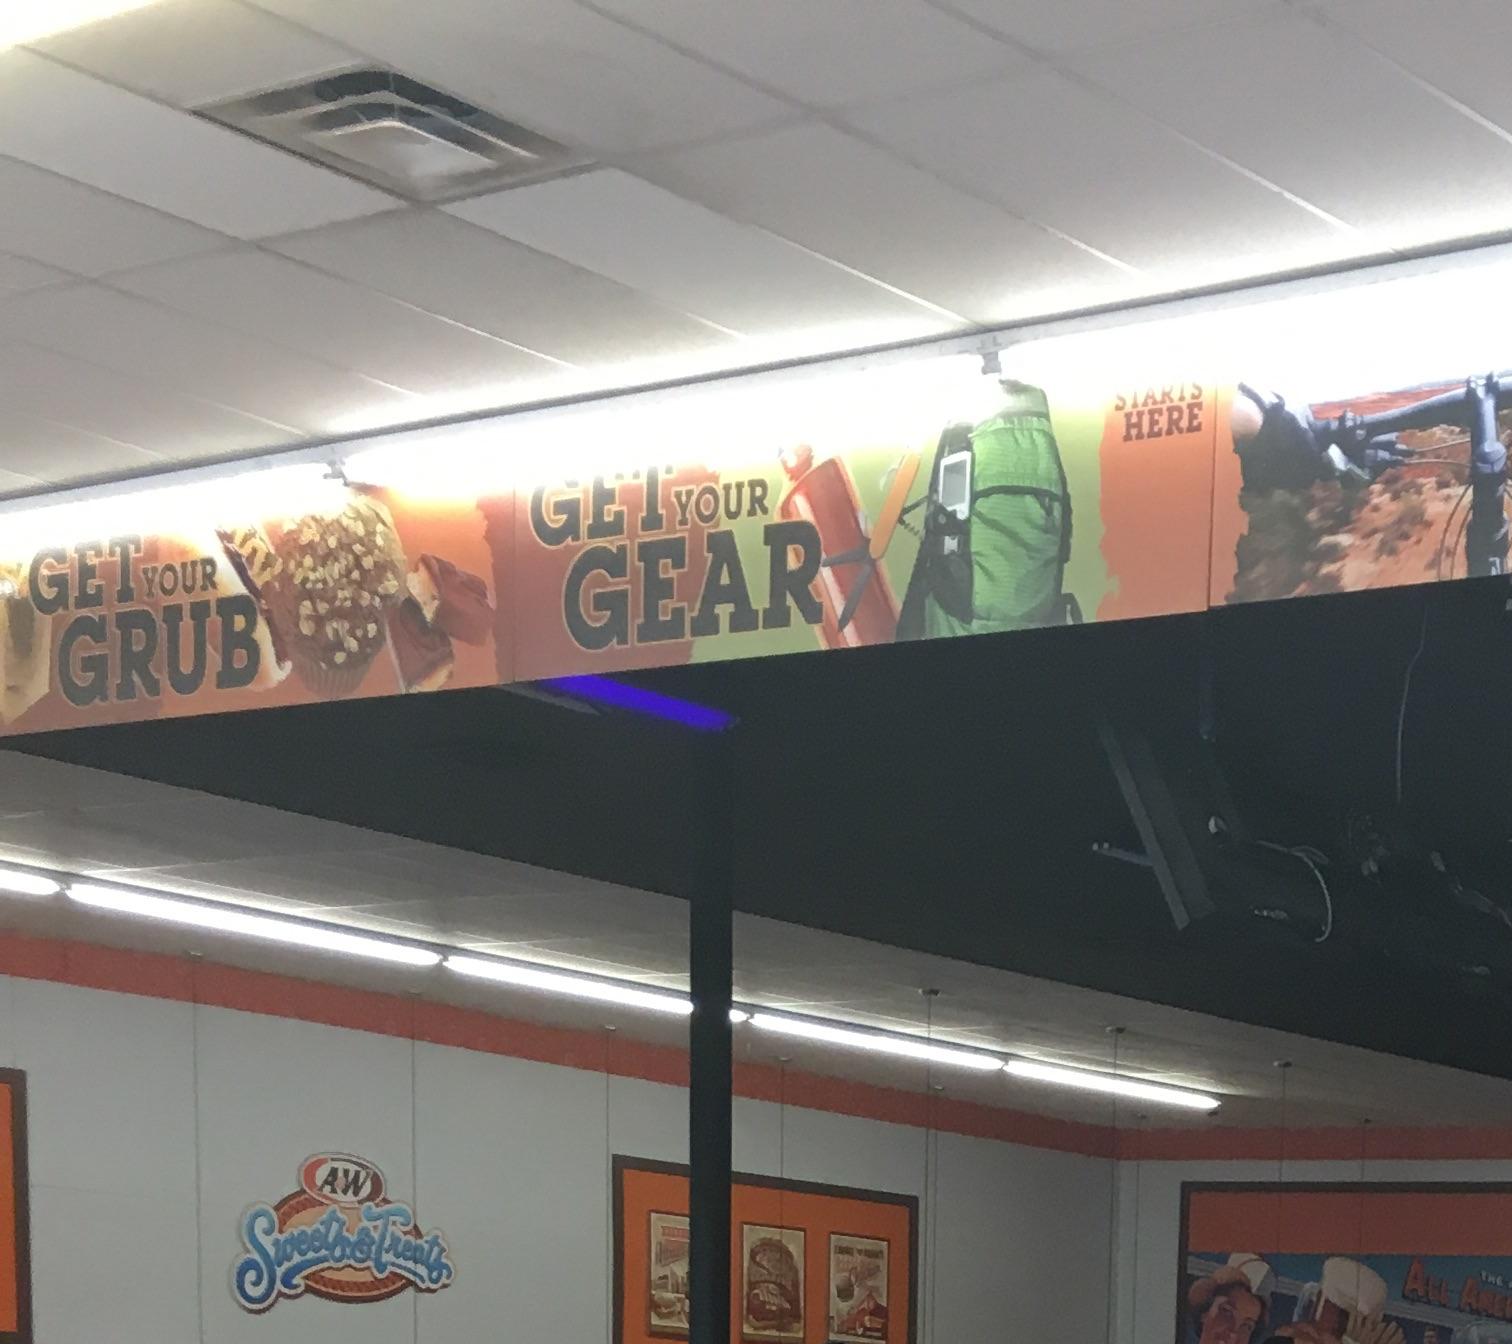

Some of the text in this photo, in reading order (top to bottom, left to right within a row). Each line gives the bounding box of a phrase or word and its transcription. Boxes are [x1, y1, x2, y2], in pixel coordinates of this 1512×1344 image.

[1122, 404, 1203, 441] HERE
[674, 479, 769, 526] YOUR
[29, 536, 218, 617] GET YOUR
[564, 520, 824, 651] GEAR
[57, 595, 260, 703] GRUB
